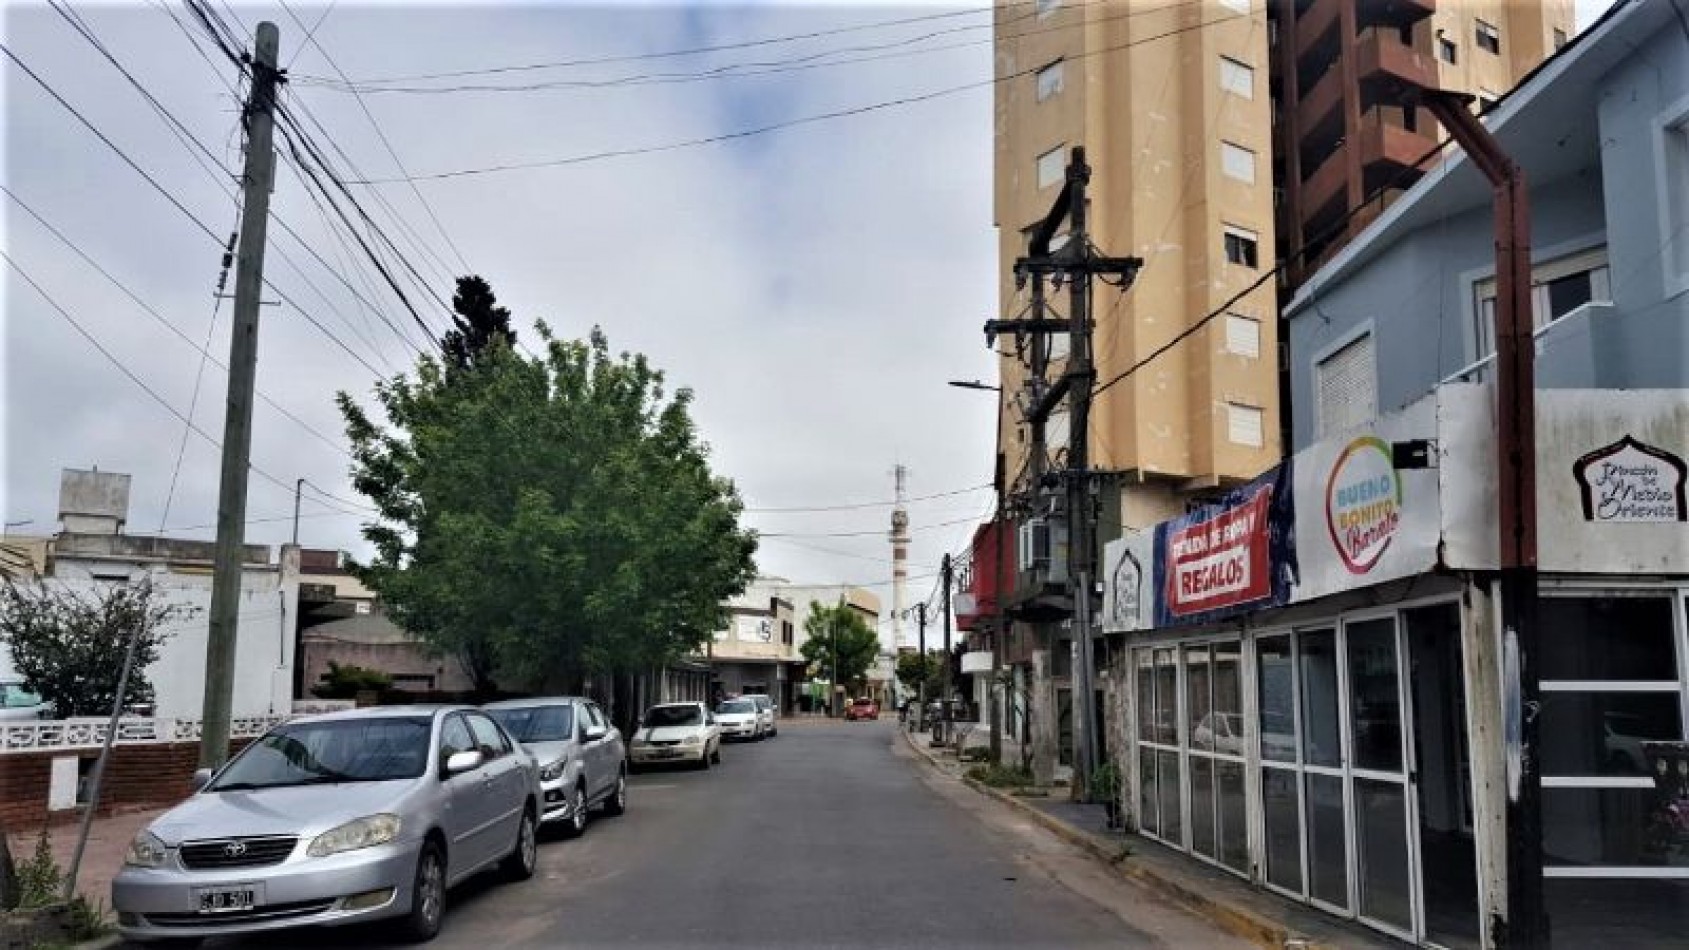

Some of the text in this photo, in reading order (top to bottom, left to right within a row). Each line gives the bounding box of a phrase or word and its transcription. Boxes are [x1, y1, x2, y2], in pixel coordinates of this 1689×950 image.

[1338, 475, 1390, 507] BUENO
[1339, 500, 1396, 529] BONITO
[1181, 555, 1244, 597] REGALOS
